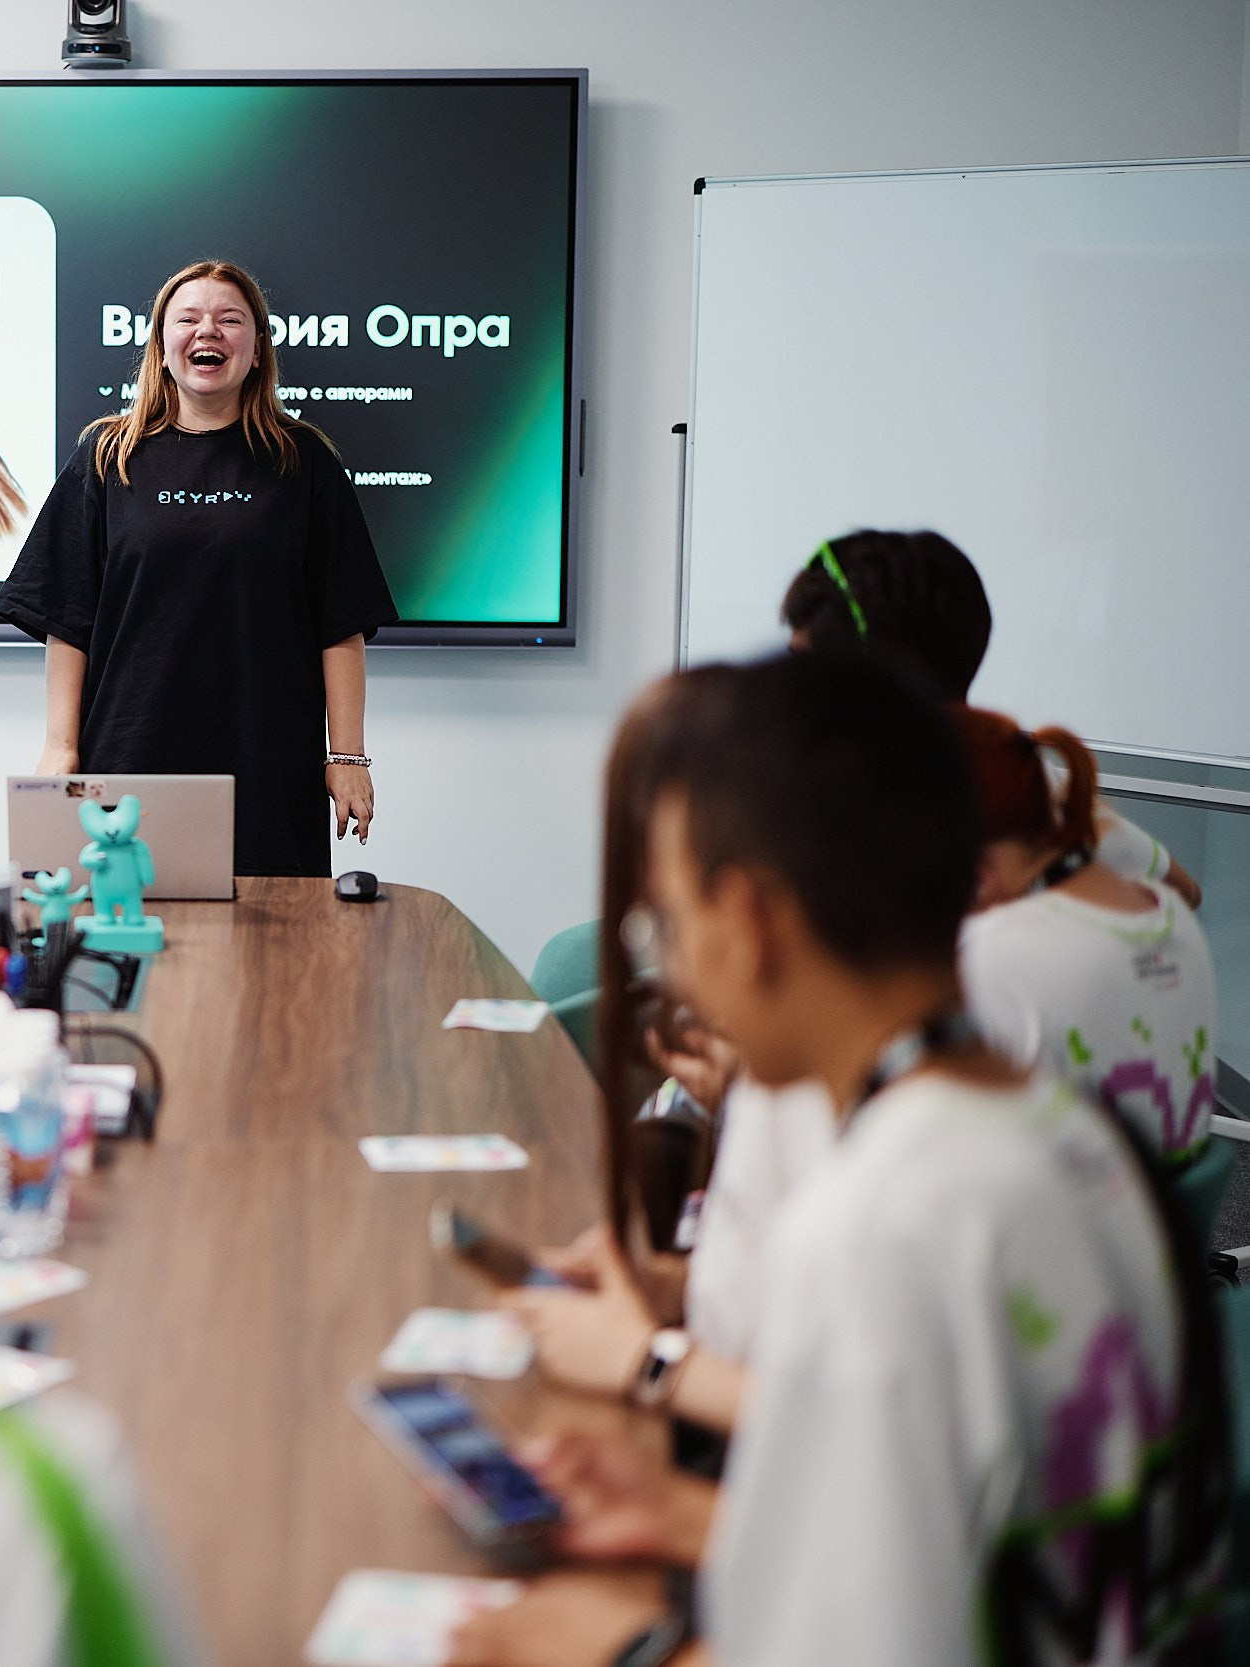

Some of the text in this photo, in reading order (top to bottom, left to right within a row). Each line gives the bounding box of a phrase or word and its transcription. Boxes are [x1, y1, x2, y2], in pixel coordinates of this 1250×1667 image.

[102, 303, 511, 358] Виия Опра
[309, 386, 324, 401] с
[325, 386, 413, 404] авторами
